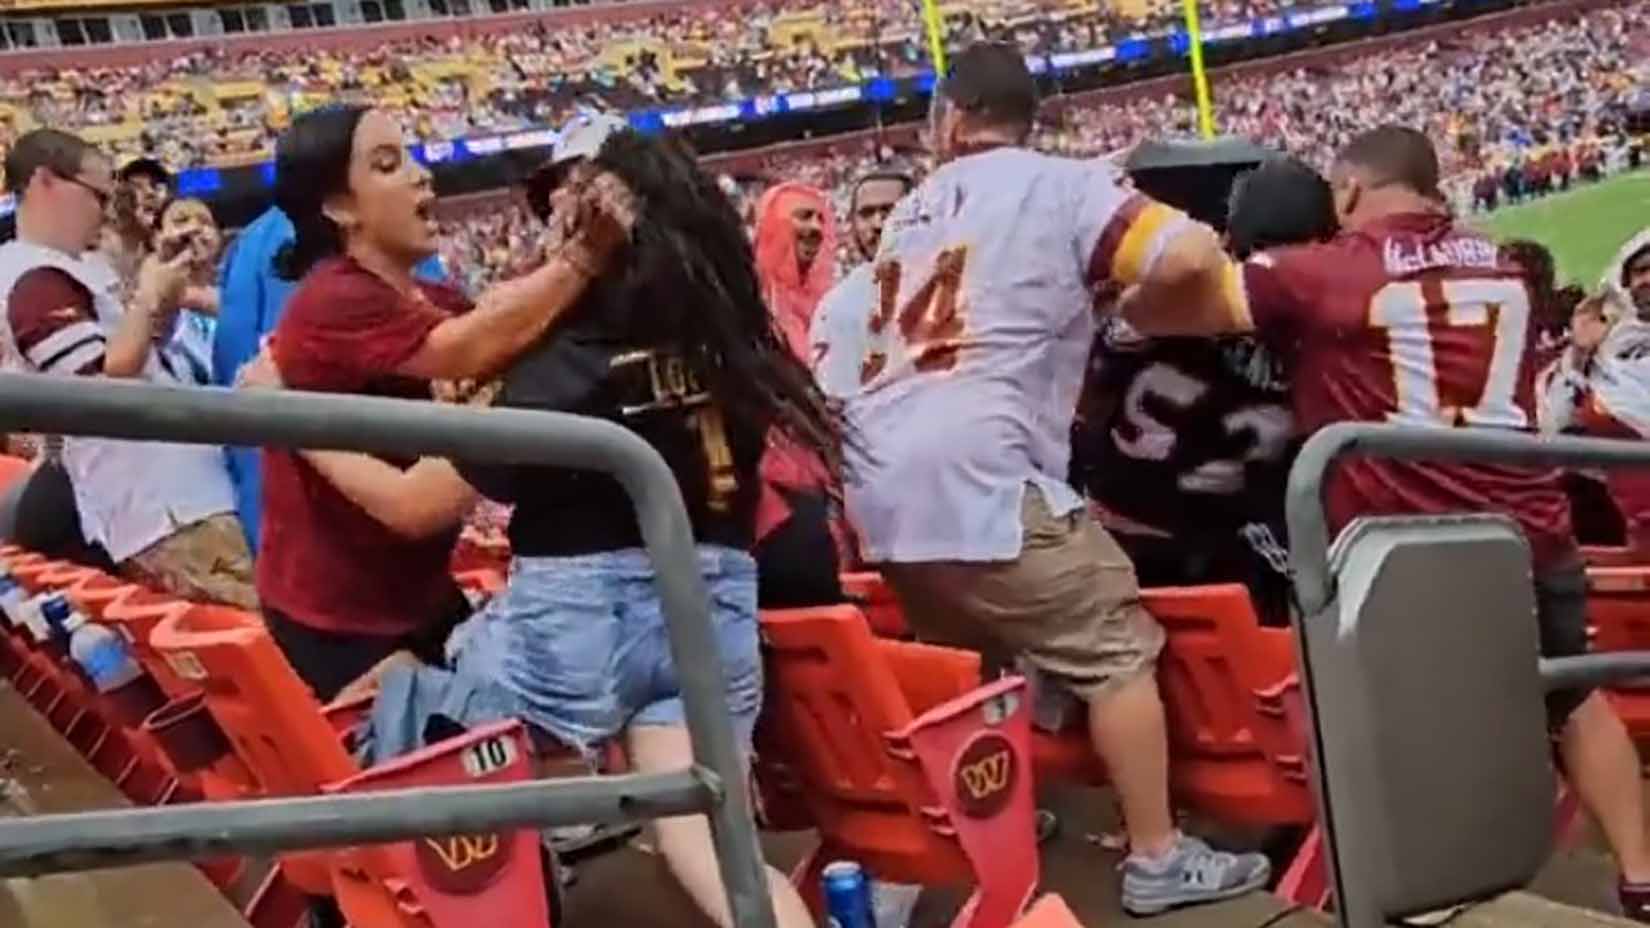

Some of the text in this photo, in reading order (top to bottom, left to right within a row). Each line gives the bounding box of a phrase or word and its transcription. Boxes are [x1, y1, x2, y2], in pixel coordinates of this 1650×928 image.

[1369, 277, 1530, 427] 17
[1109, 362, 1295, 491] 52
[472, 739, 508, 772] 10
